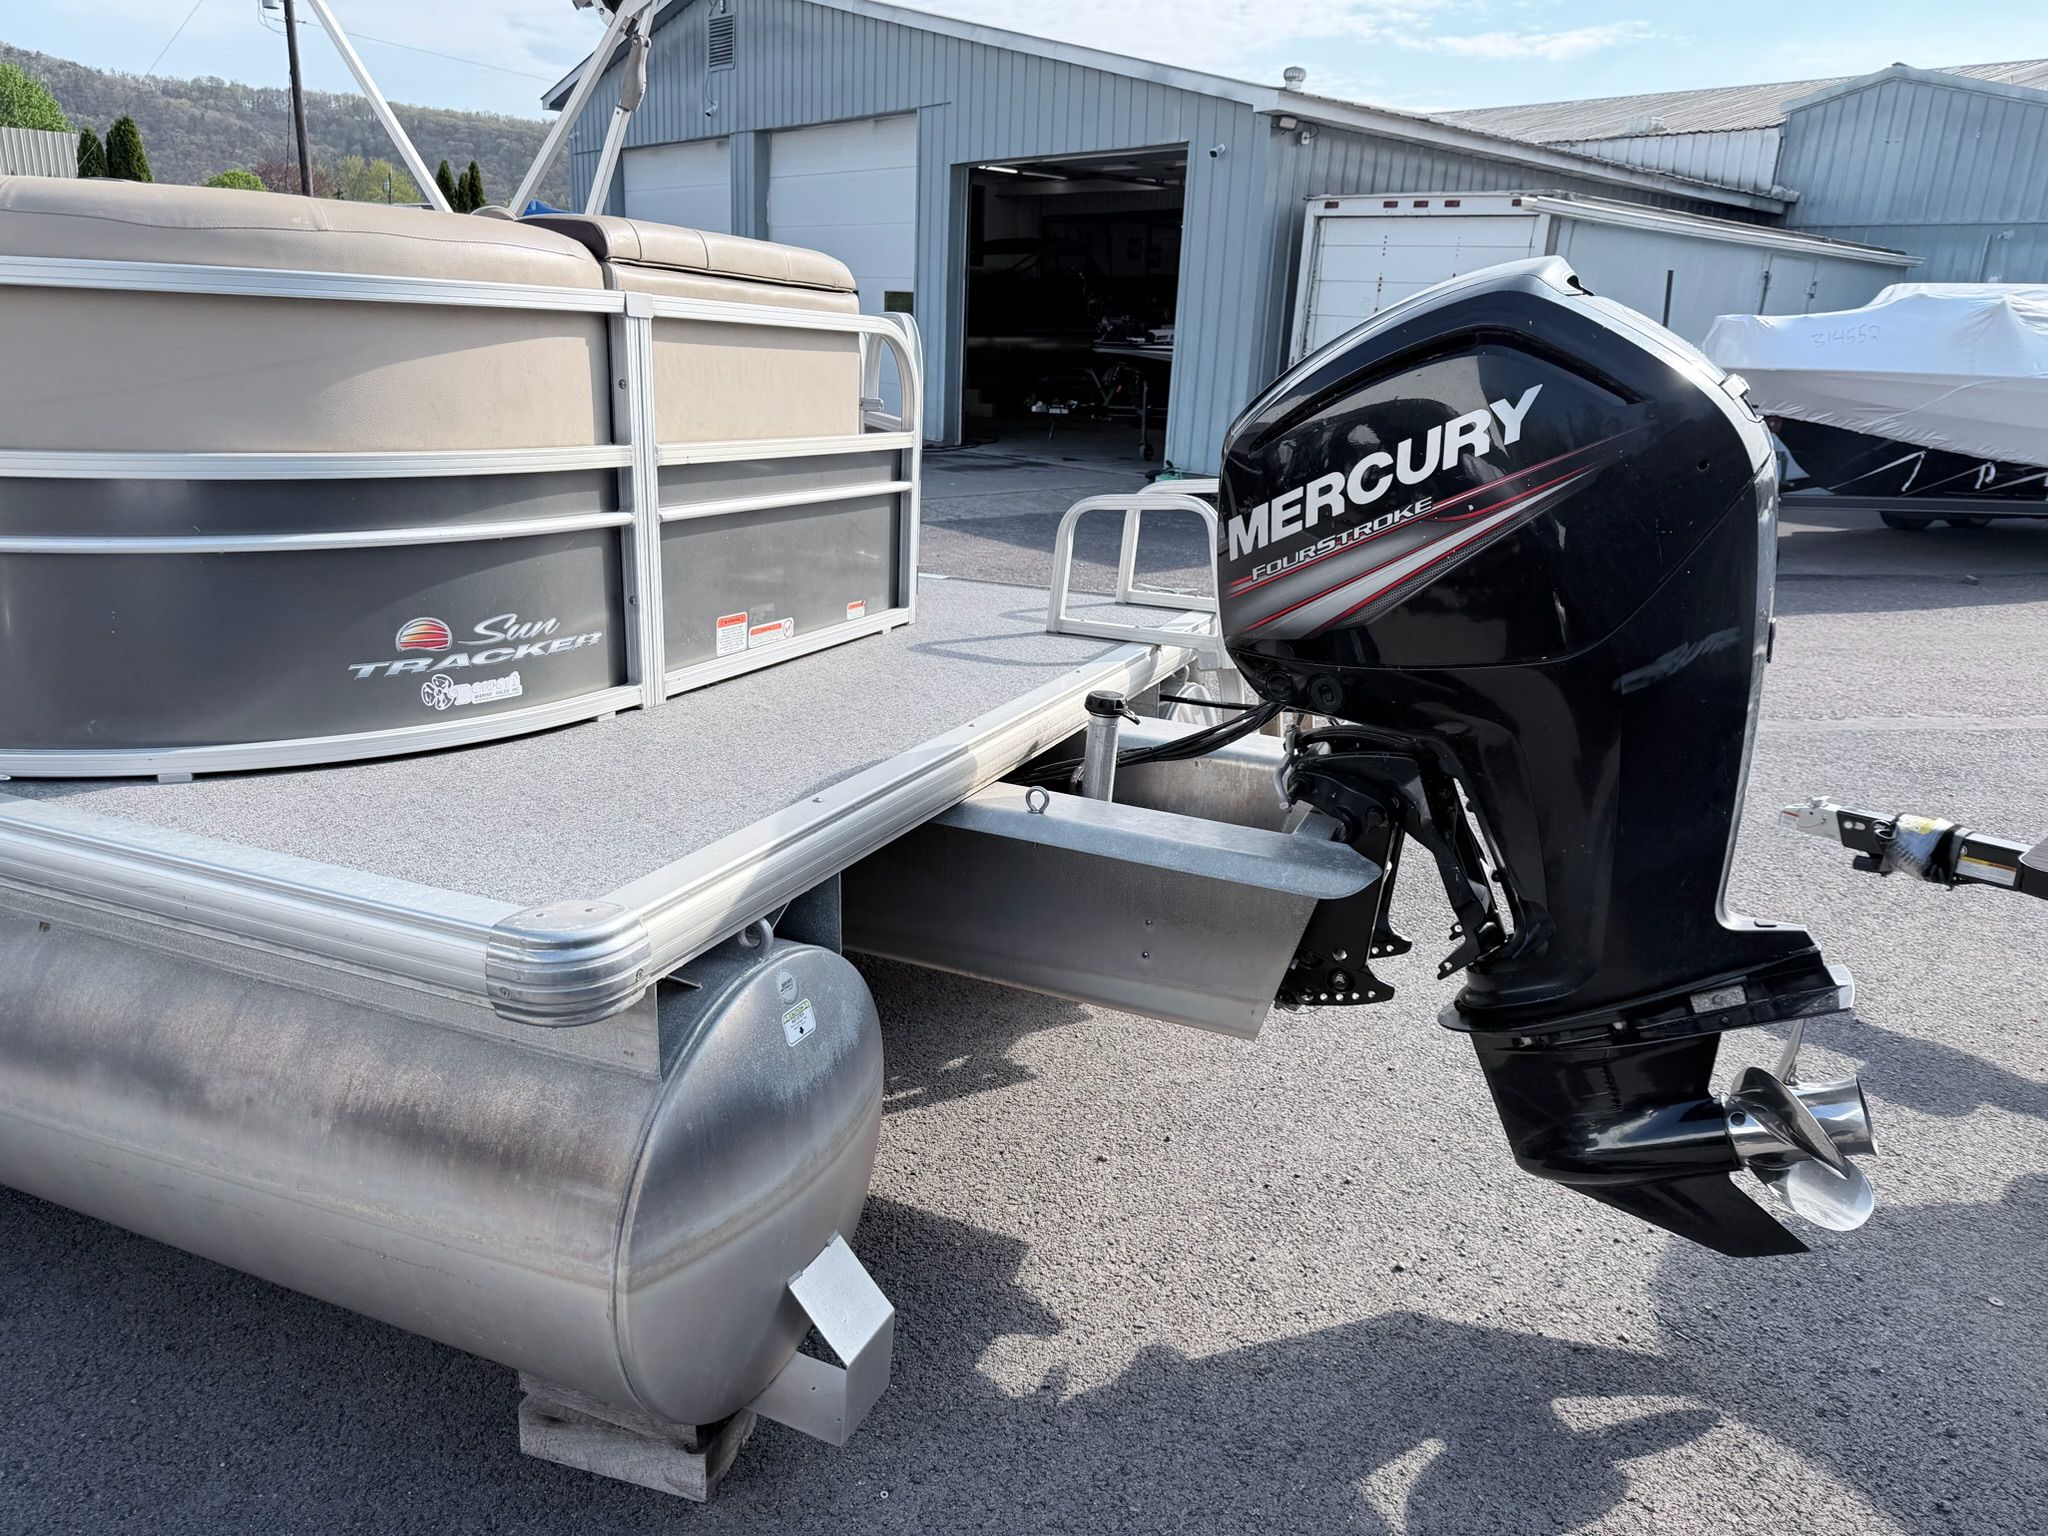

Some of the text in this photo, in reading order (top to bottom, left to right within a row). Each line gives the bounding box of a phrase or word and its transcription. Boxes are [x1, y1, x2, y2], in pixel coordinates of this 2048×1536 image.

[1228, 383, 1543, 562] MERCURY
[1252, 496, 1433, 581] FOURSTROKE
[348, 632, 602, 680] TRACKER
[458, 613, 560, 646] Sun
